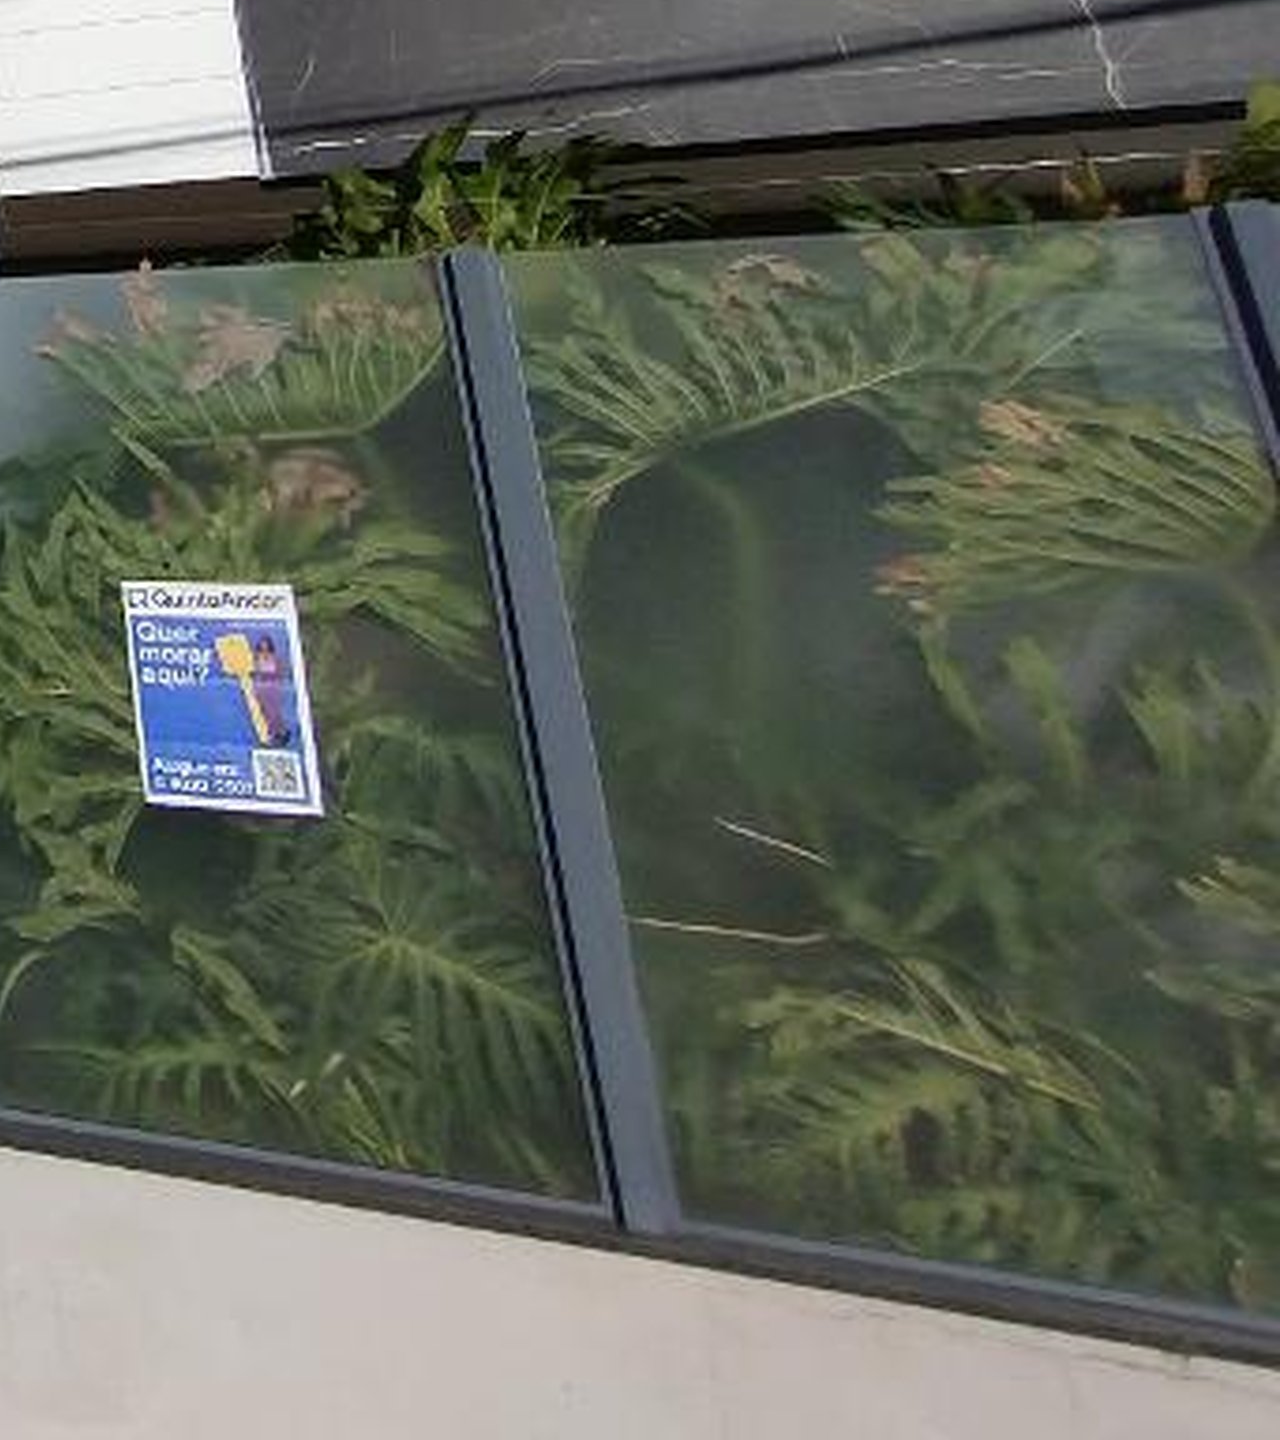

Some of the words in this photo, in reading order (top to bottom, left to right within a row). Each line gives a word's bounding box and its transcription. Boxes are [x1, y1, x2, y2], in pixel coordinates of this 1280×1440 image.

[135, 620, 201, 643] Quer
[139, 646, 213, 666] morar
[141, 665, 210, 691] aqui?
